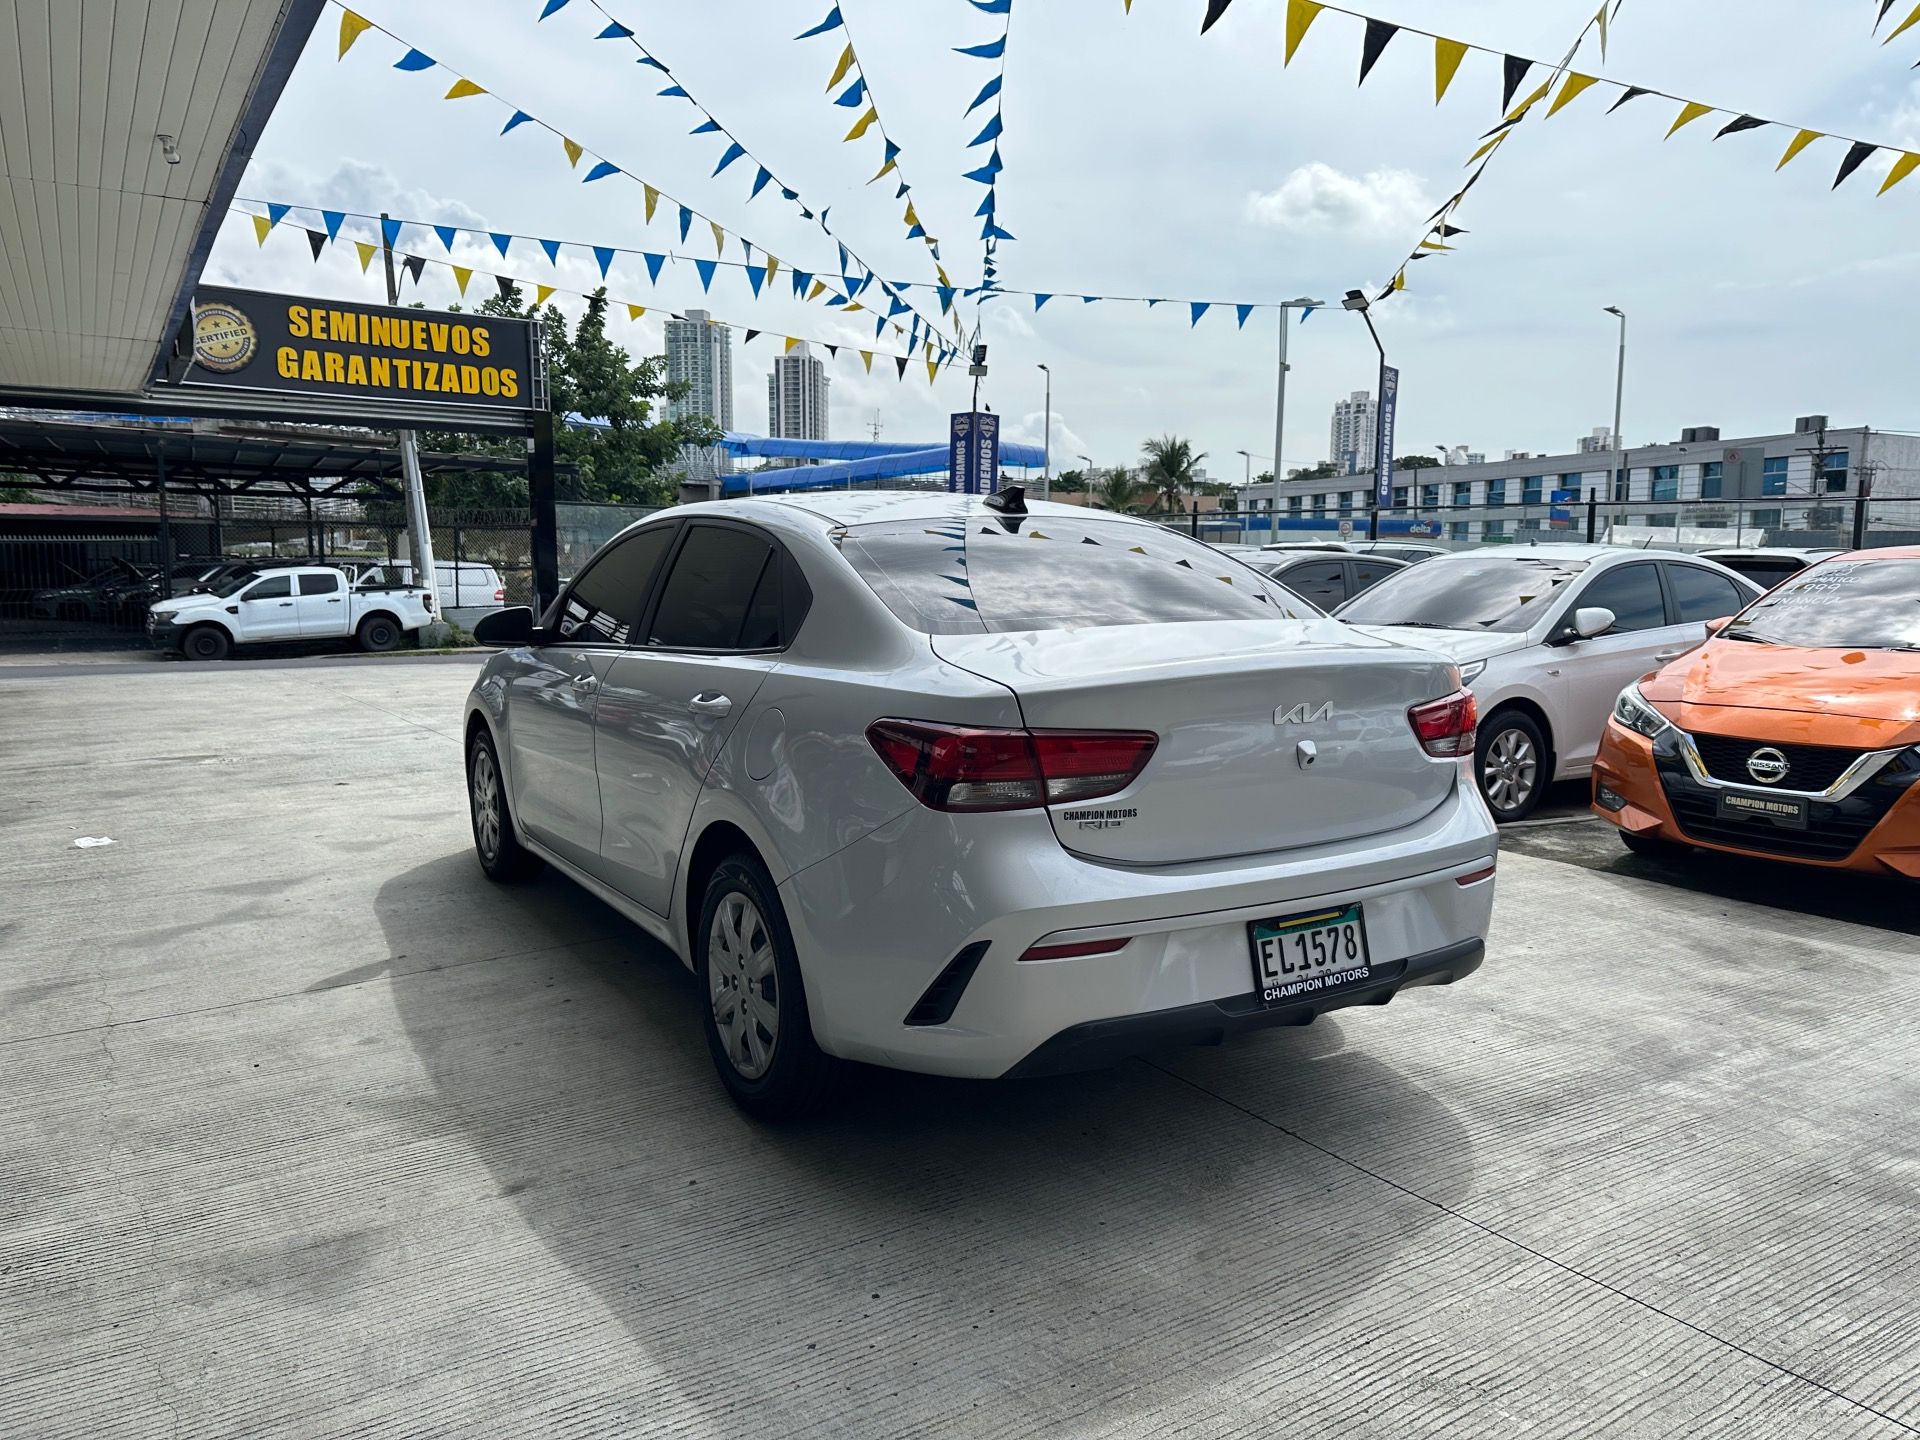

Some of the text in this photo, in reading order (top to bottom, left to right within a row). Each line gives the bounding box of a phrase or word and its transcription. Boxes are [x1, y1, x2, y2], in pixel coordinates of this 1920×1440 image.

[288, 304, 490, 357] SEMINUEVOS
[277, 346, 519, 398] GARANTIZADOS
[1409, 524, 1431, 533] delta
[1273, 700, 1334, 725] KIA
[1750, 760, 1787, 772] NISSAN
[1063, 808, 1138, 821] CHAMPION MOTORS
[1725, 796, 1765, 809] CHAMPION
[1766, 802, 1799, 815] MOTORS
[1261, 924, 1358, 978] EL1578
[1264, 978, 1323, 1001] CHAMPION
[1325, 967, 1369, 987] MOTORS
